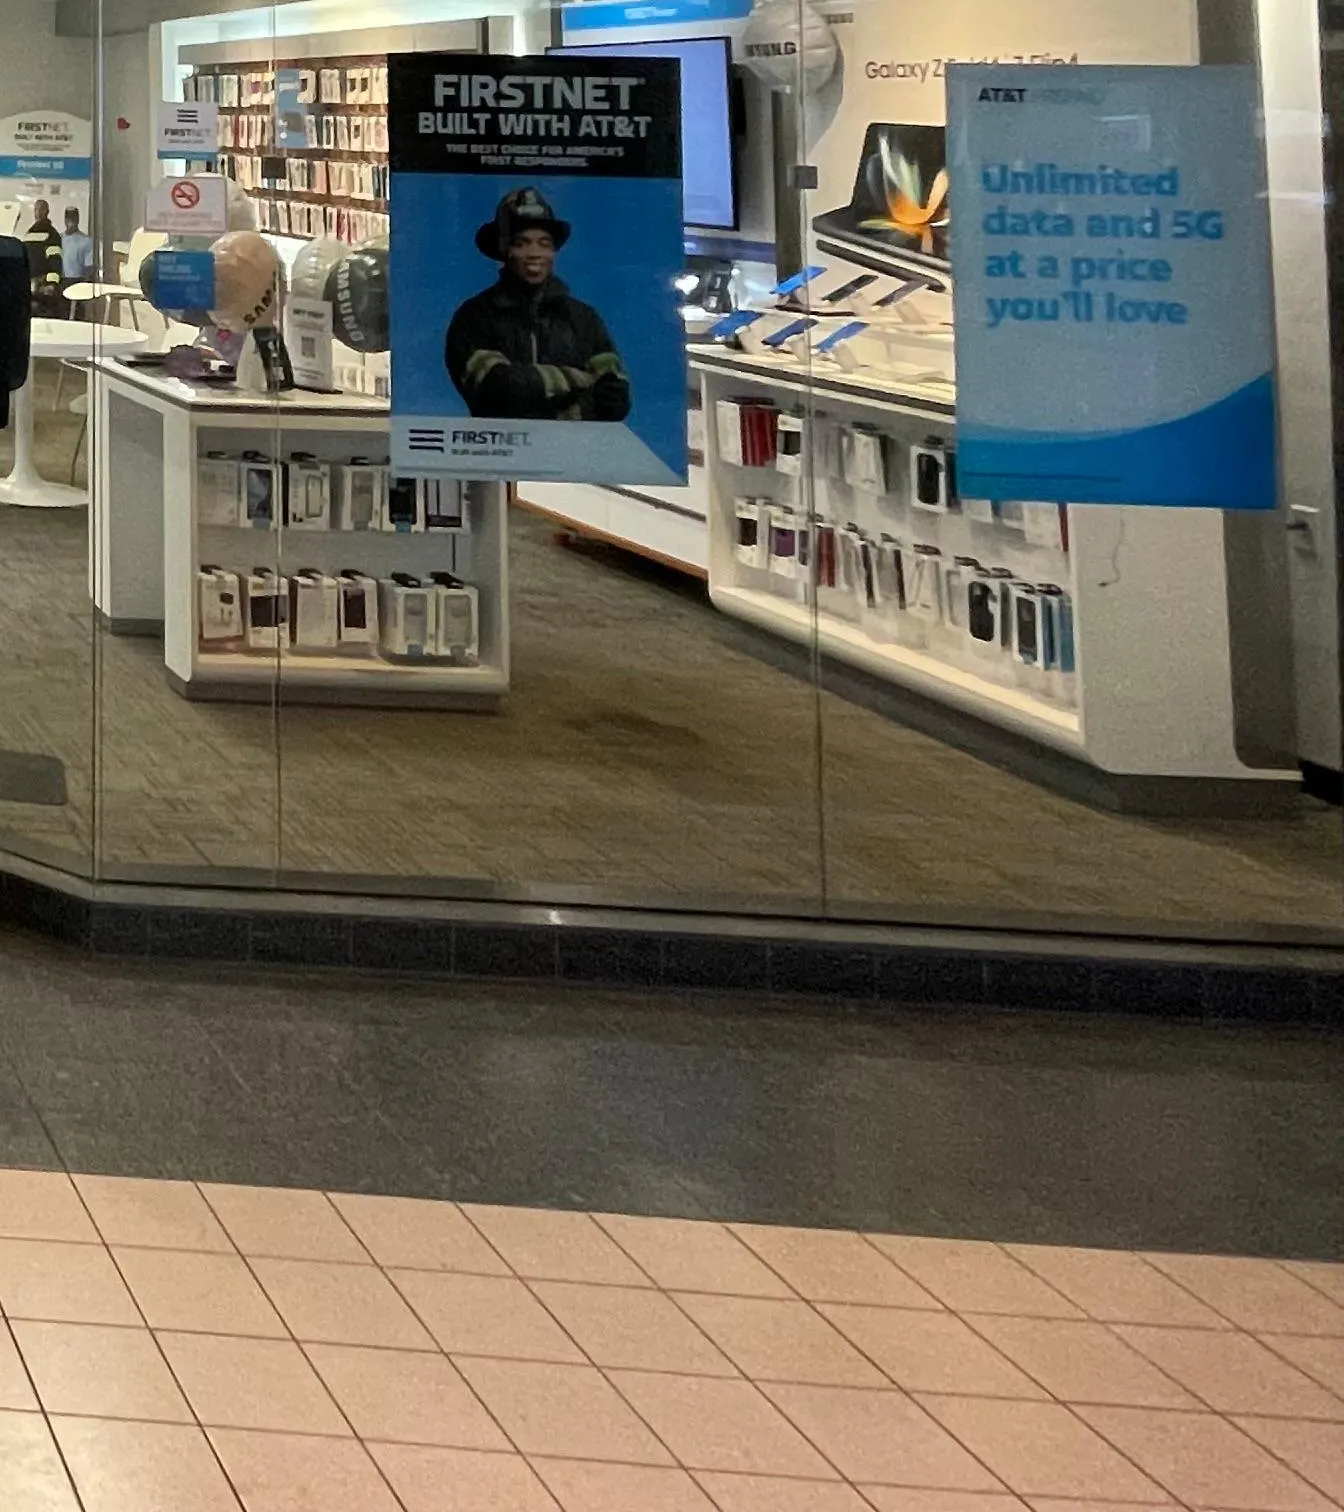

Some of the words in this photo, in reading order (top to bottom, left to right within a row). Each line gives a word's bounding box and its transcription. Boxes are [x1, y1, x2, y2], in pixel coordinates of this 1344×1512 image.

[865, 59, 929, 84] Galaxy
[932, 59, 944, 78] Z
[433, 74, 638, 110] FIRSTNET
[978, 87, 1028, 103] AT&T
[17, 121, 69, 132] FIRSTNET
[164, 127, 211, 137] FIRSTNET
[418, 112, 491, 135] BUILT
[498, 114, 571, 136] WITH
[578, 115, 652, 138] AT&T
[446, 144, 468, 154] THE
[981, 163, 1179, 196] Unlimited
[982, 205, 1074, 237] data
[1085, 207, 1161, 238] and
[1173, 210, 1224, 240] 5G
[985, 250, 1027, 278] at
[1037, 255, 1059, 278] a
[1071, 248, 1173, 288] price
[986, 290, 1093, 329] you'll
[1106, 291, 1188, 325] love
[451, 430, 530, 446] FIRSTNET
